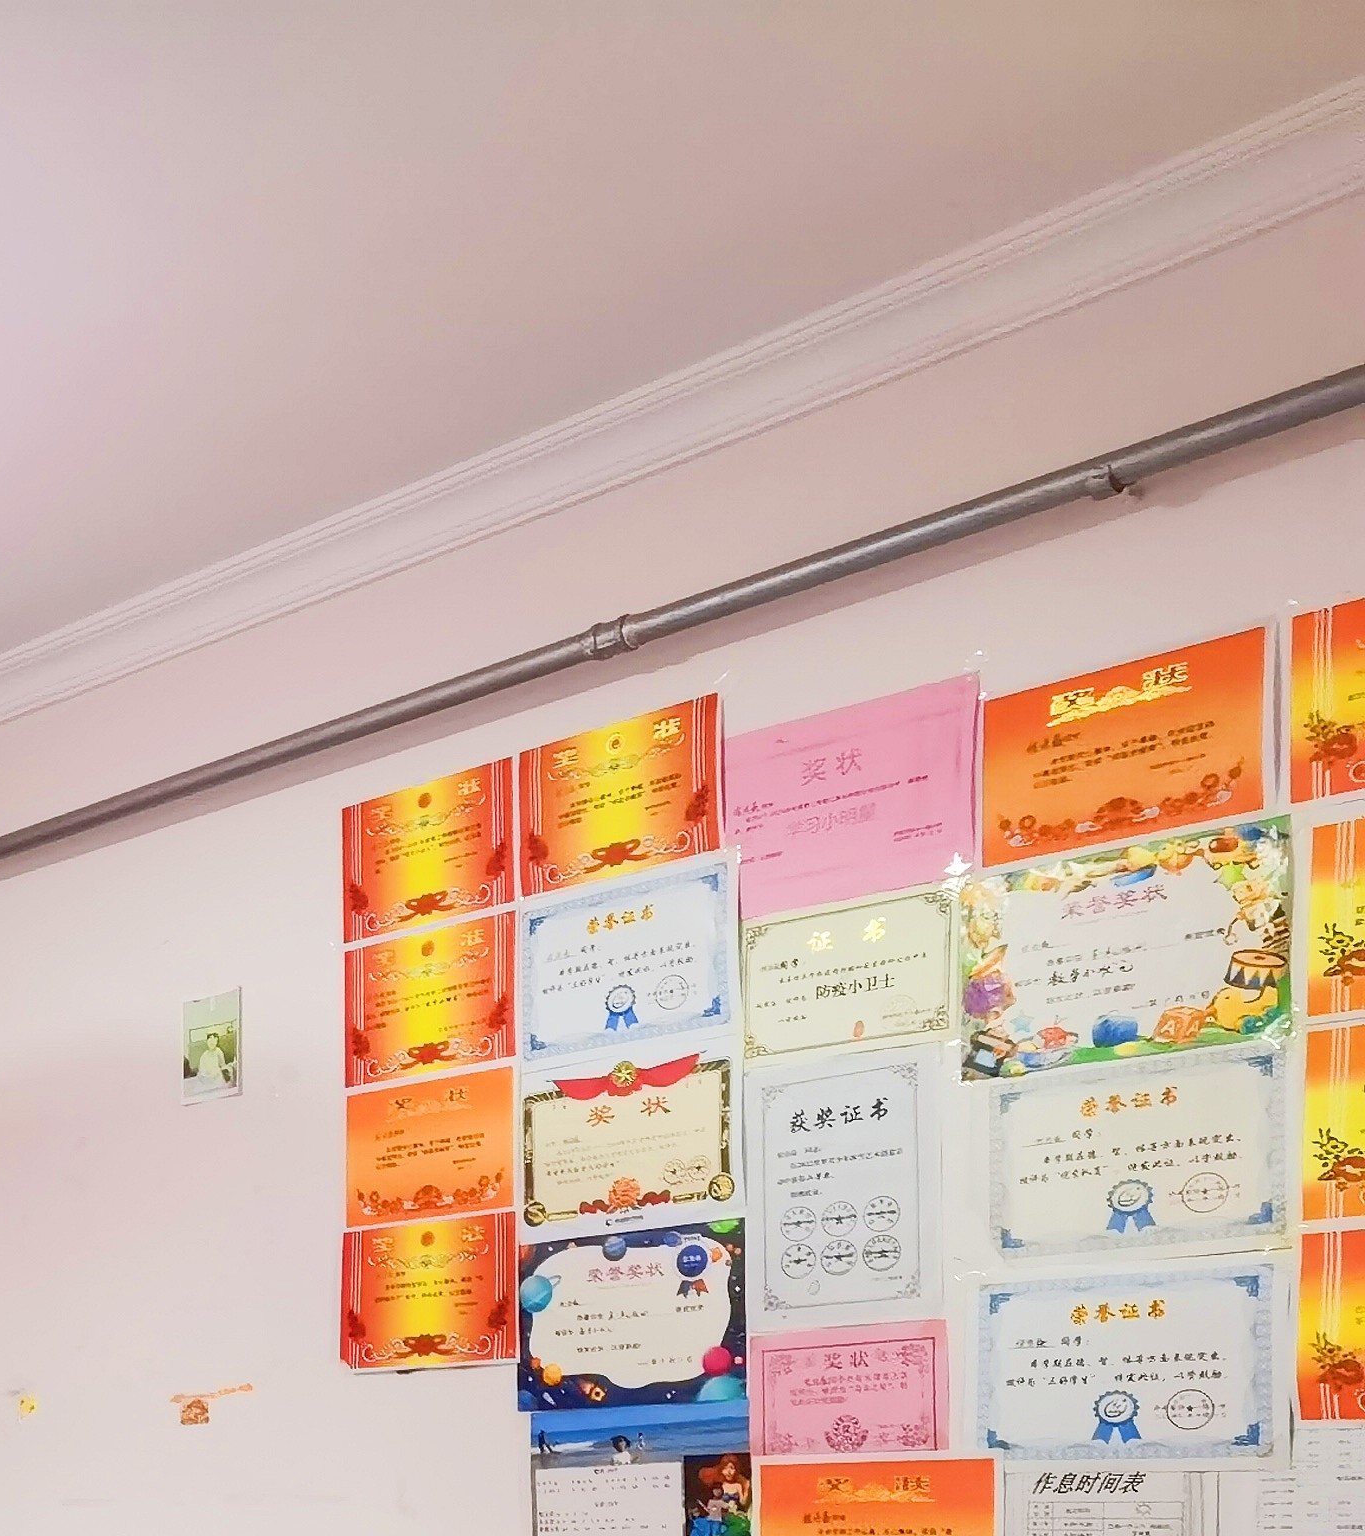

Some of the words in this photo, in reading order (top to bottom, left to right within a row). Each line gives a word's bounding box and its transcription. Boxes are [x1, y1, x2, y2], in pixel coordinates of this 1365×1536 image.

[801, 748, 862, 786] 奖状
[816, 973, 895, 1000] 防疫小卫士
[586, 1096, 671, 1127] 奖状
[790, 1097, 889, 1133] 获奖证书
[824, 1351, 869, 1369] 奖状
[1032, 1471, 1146, 1494] 作息时间表
